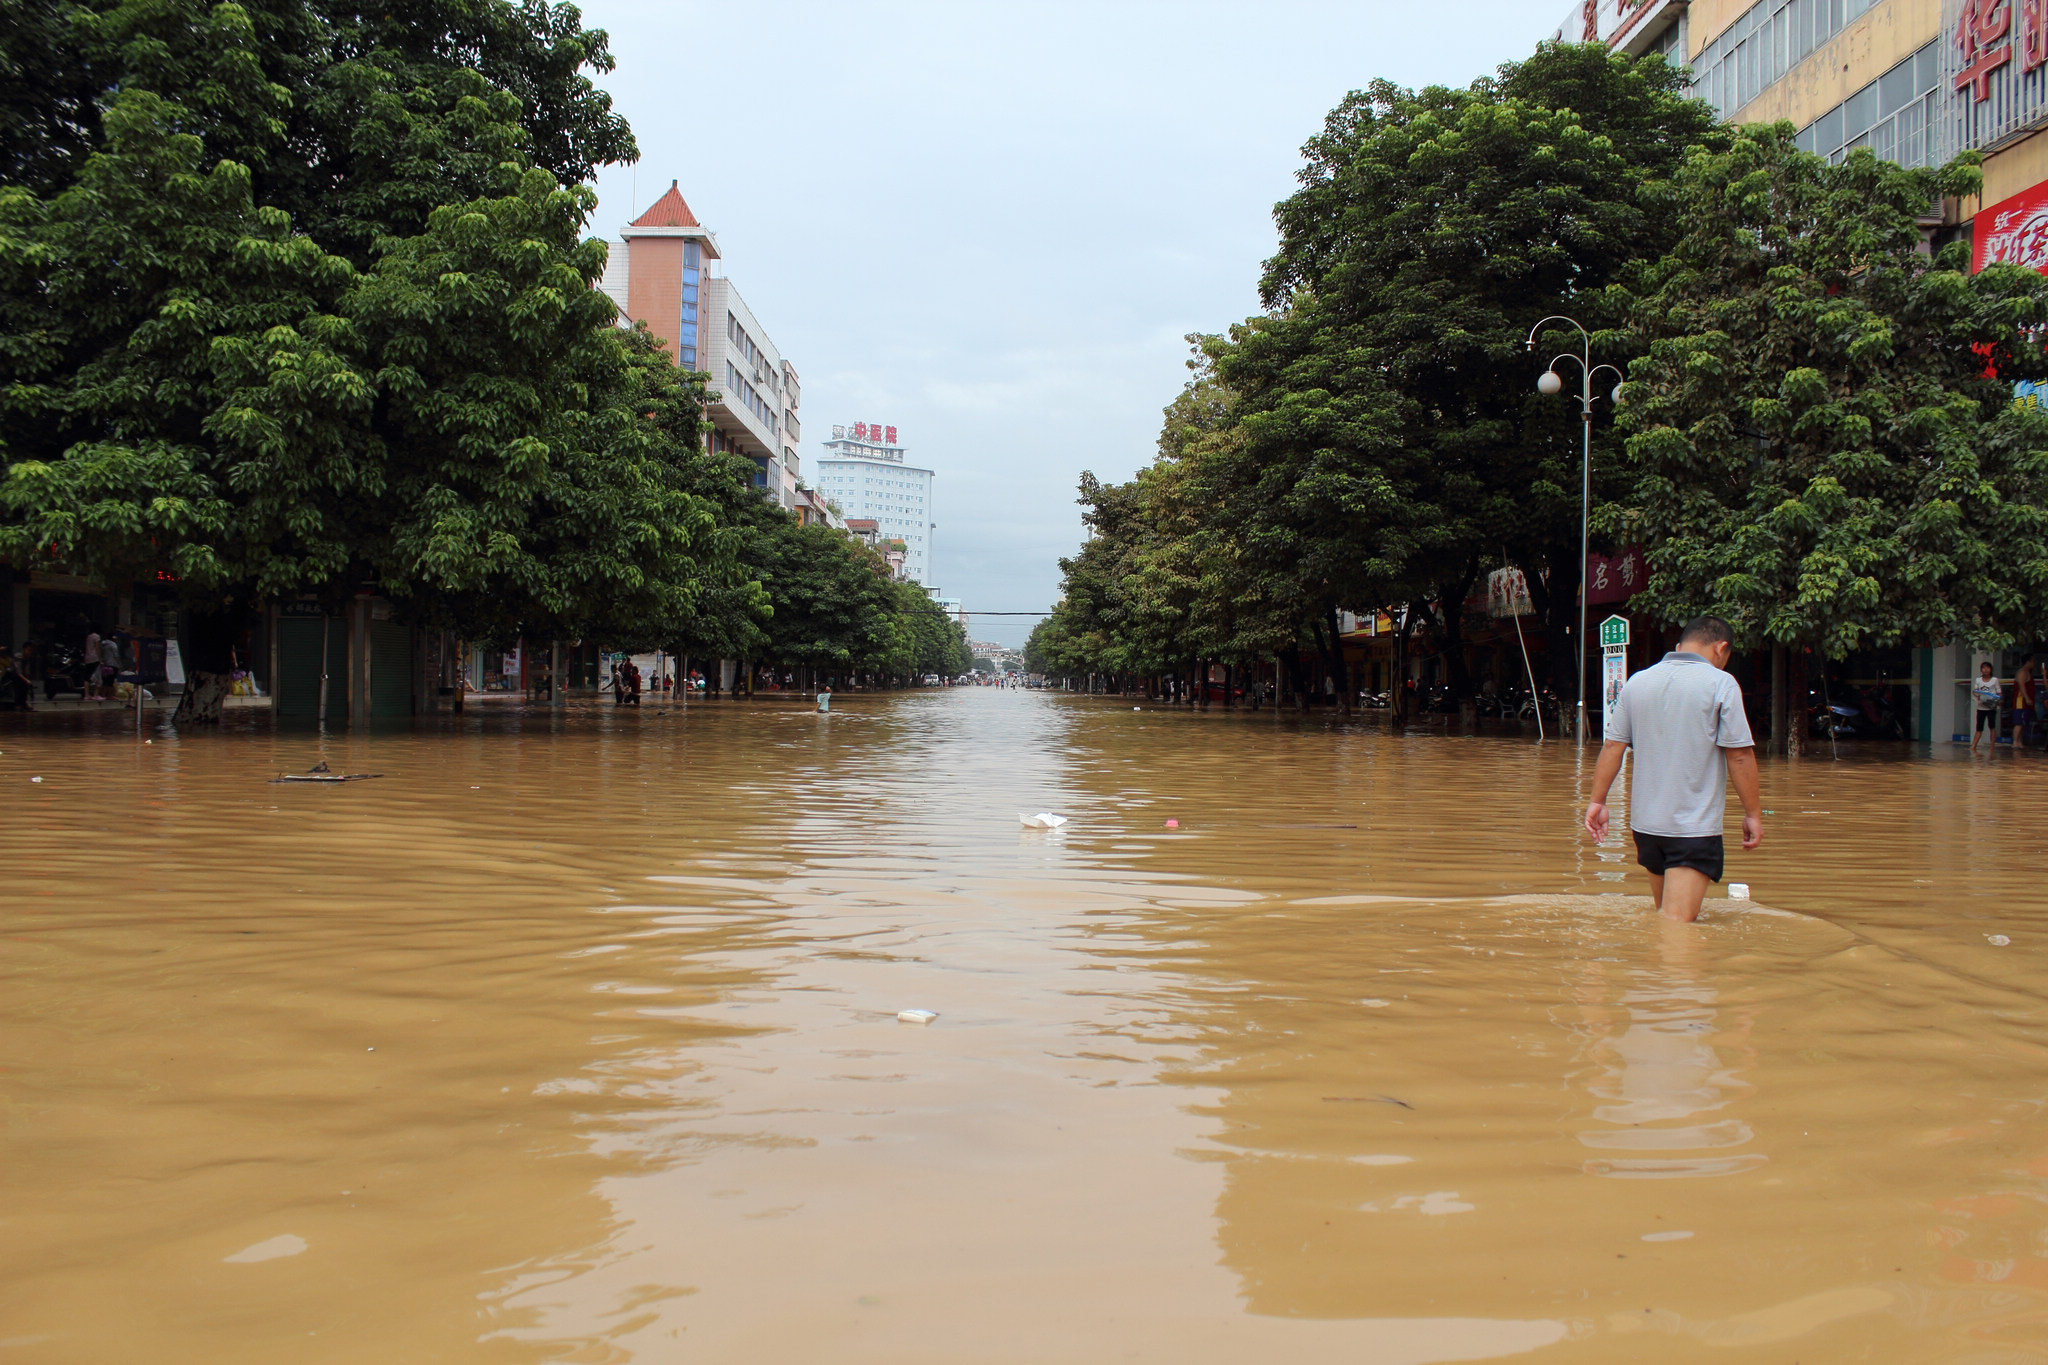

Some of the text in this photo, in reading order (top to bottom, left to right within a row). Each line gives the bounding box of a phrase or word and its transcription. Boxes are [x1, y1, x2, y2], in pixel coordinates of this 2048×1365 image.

[1994, 209, 2025, 231] 统一
[855, 421, 897, 444] 中医院
